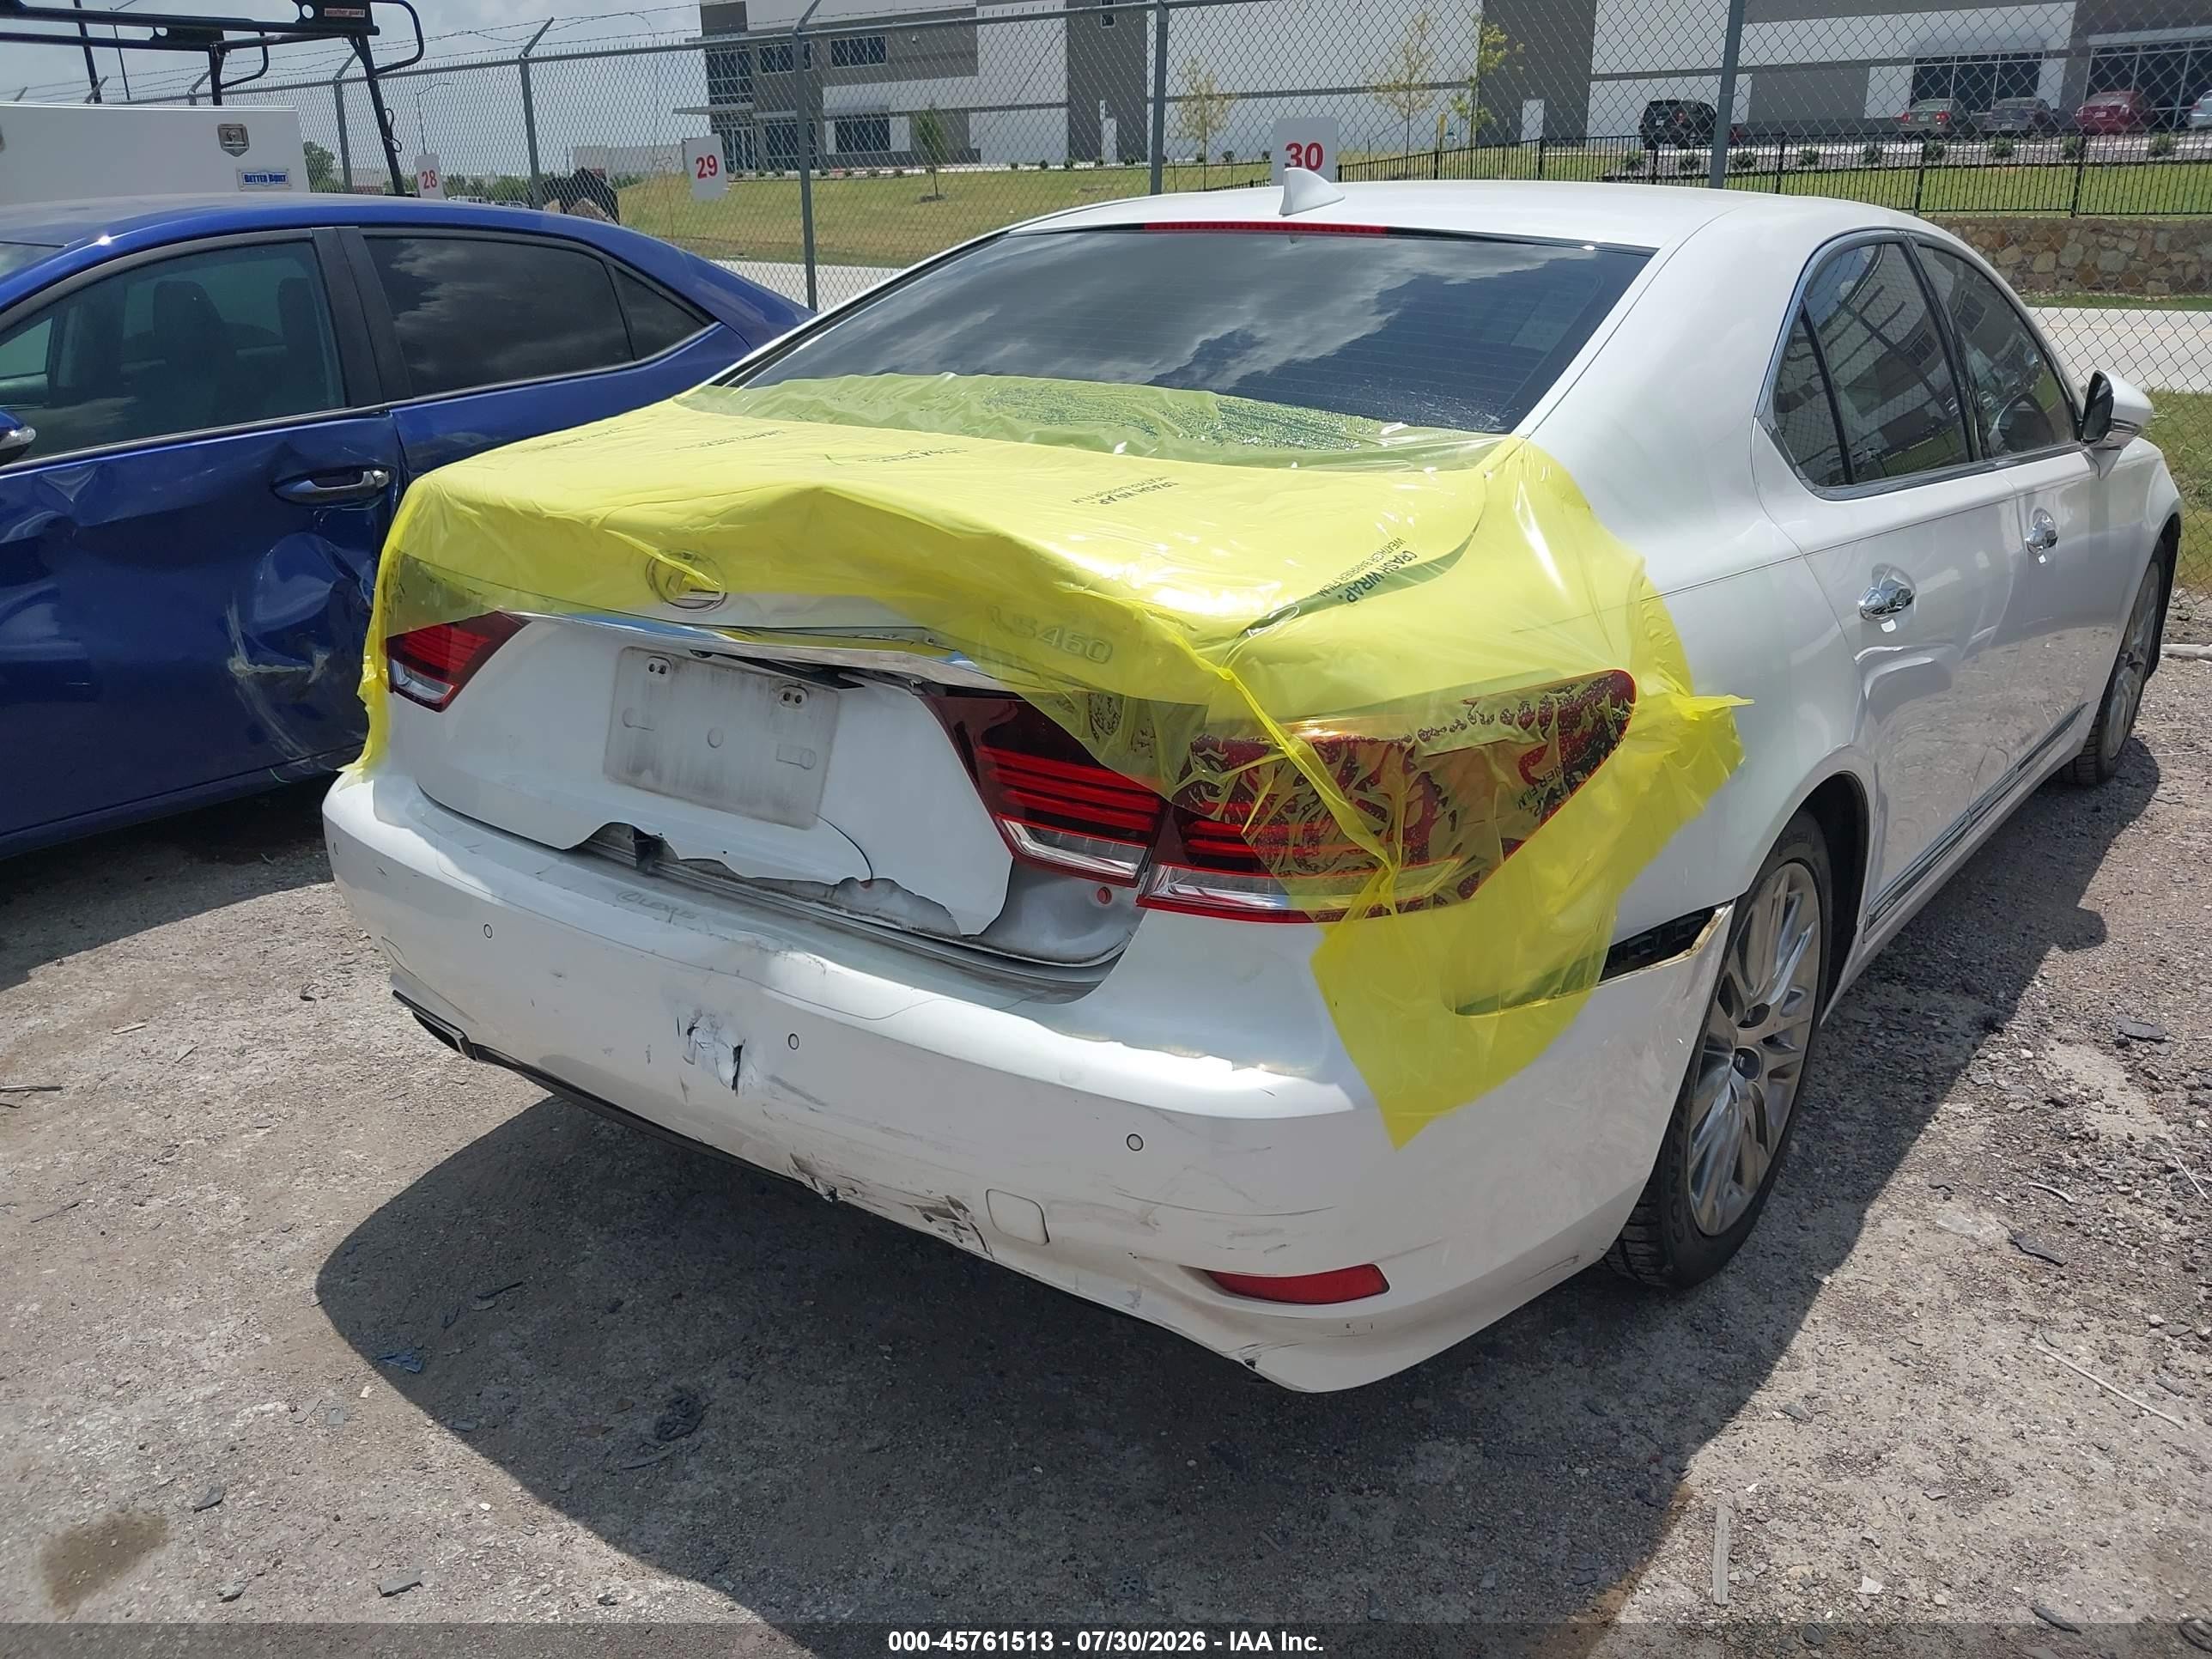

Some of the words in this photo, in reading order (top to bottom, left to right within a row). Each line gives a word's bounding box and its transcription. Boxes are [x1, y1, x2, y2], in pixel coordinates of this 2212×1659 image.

[696, 155, 718, 179] 29
[1285, 142, 1323, 172] 30
[422, 169, 437, 189] 28
[1370, 537, 1407, 564] WEATHER
[1377, 550, 1417, 574] CRASH
[1340, 559, 1373, 582] BARRIER
[1317, 579, 1342, 598] FILM
